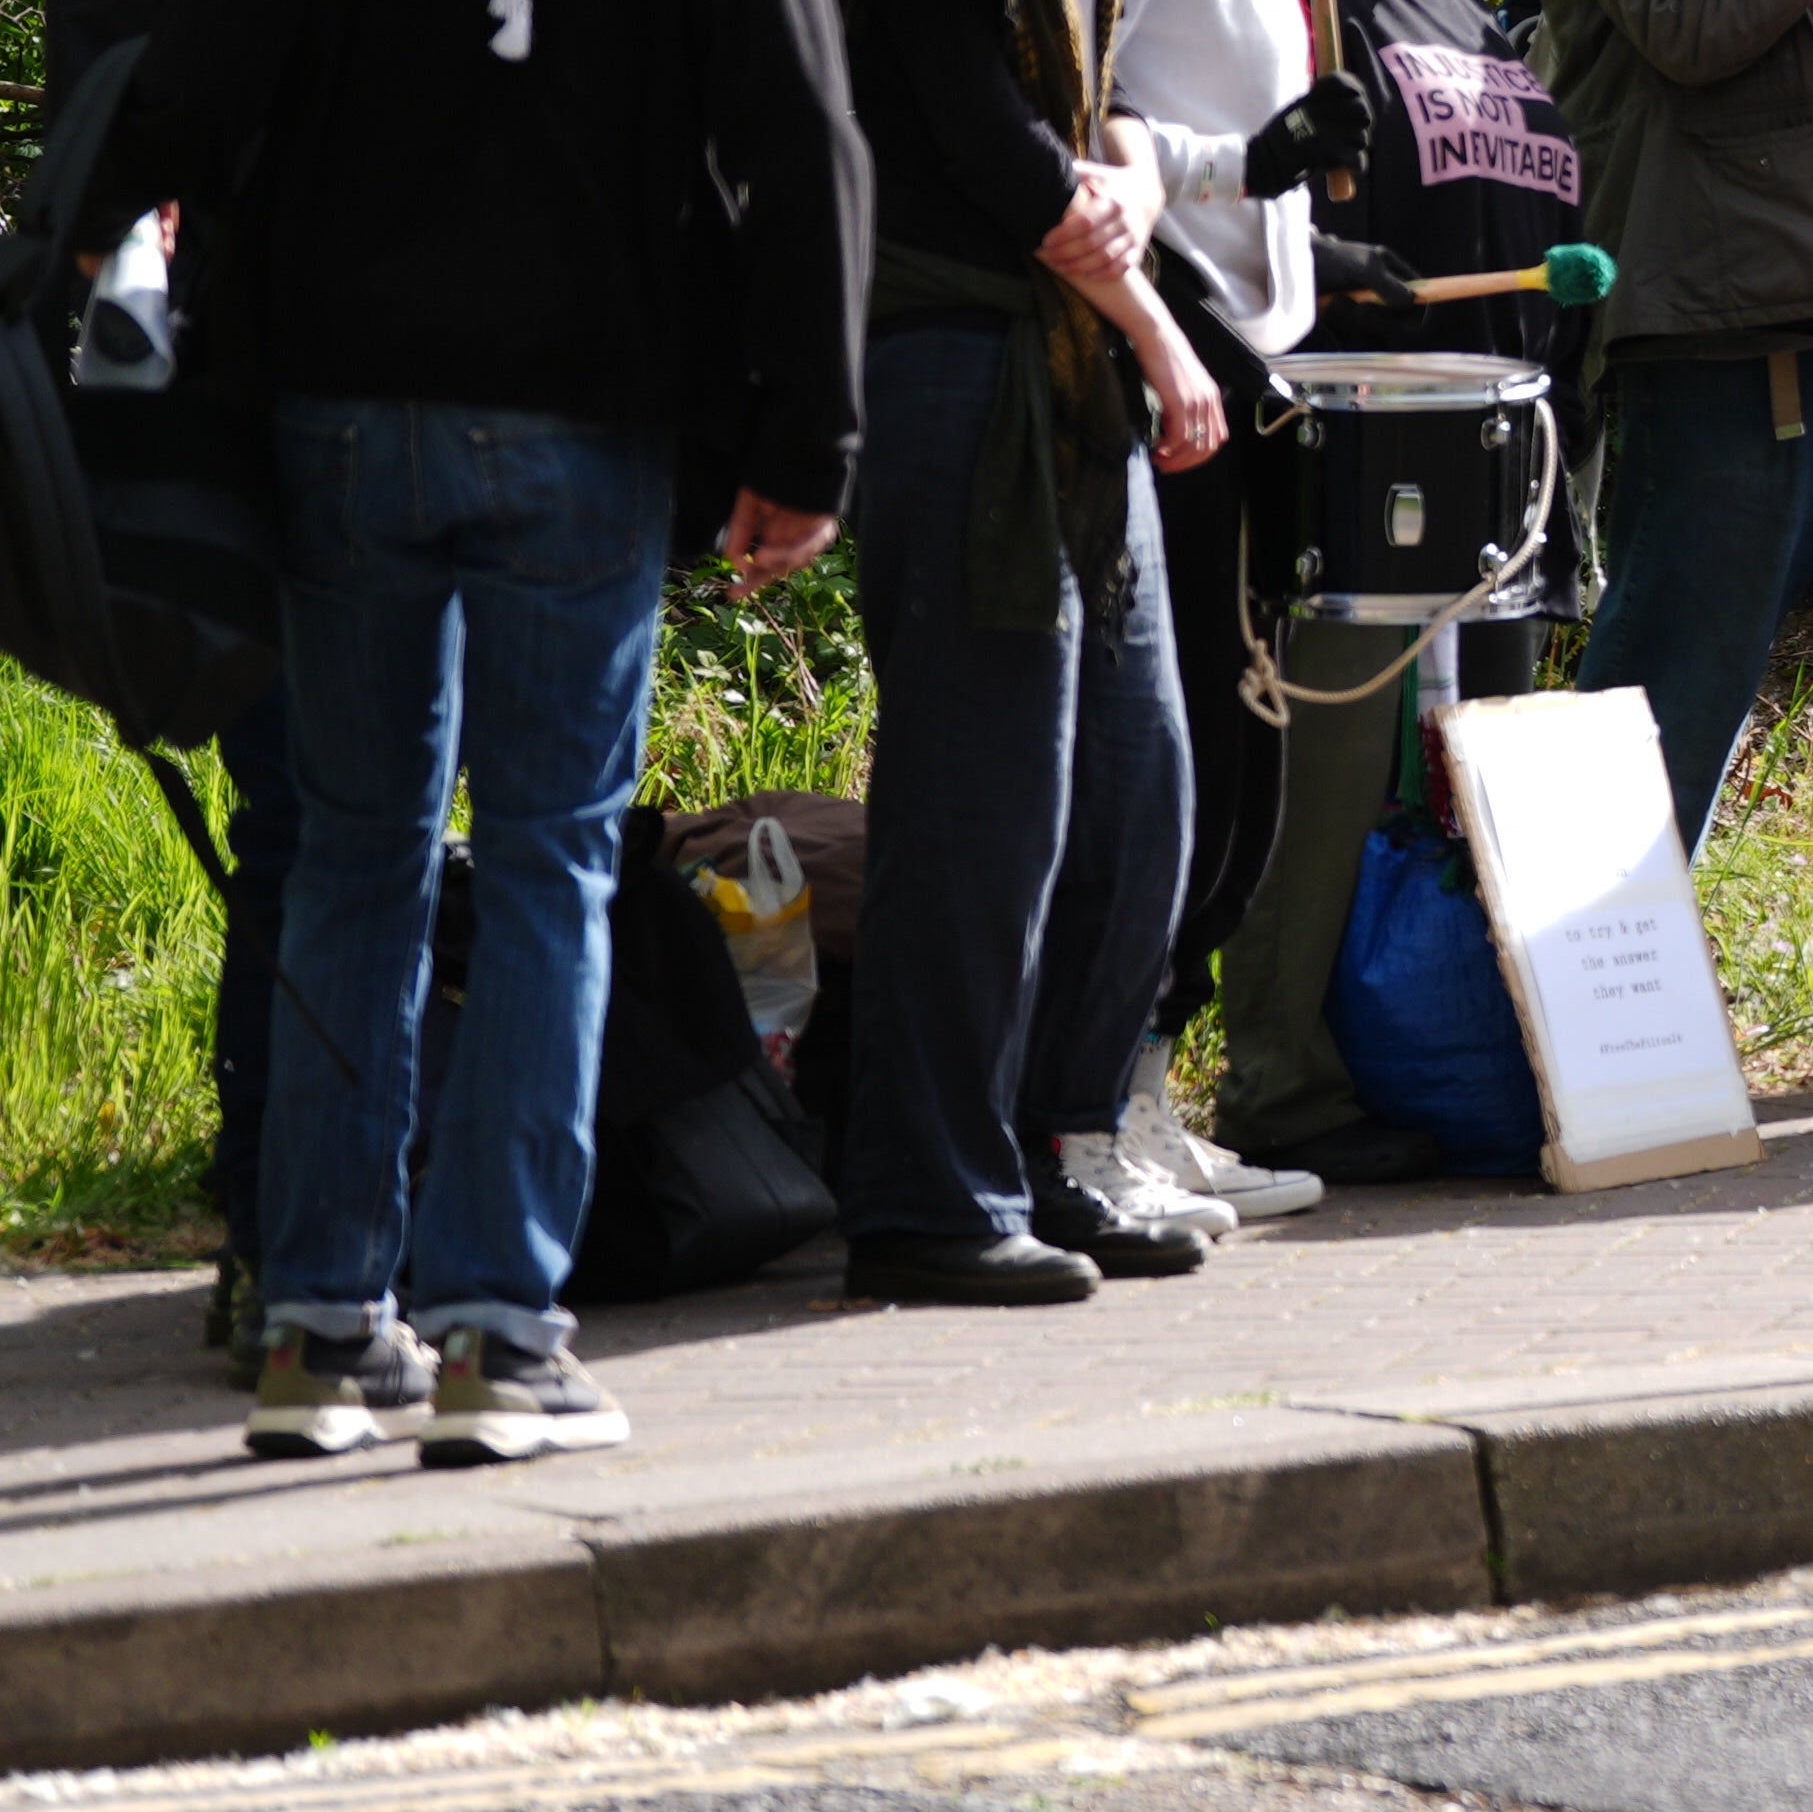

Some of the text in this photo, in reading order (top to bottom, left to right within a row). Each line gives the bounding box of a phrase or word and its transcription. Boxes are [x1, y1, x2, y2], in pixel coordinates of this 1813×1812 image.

[1394, 51, 1550, 96] INJUSTICE
[1415, 88, 1512, 126] IS NOT
[1429, 130, 1573, 193] INEVITABLE
[1564, 929, 1581, 943] to
[1588, 925, 1612, 941] try
[1635, 918, 1659, 937] get
[1581, 949, 1659, 971] the answer
[1592, 978, 1664, 1000] they want
